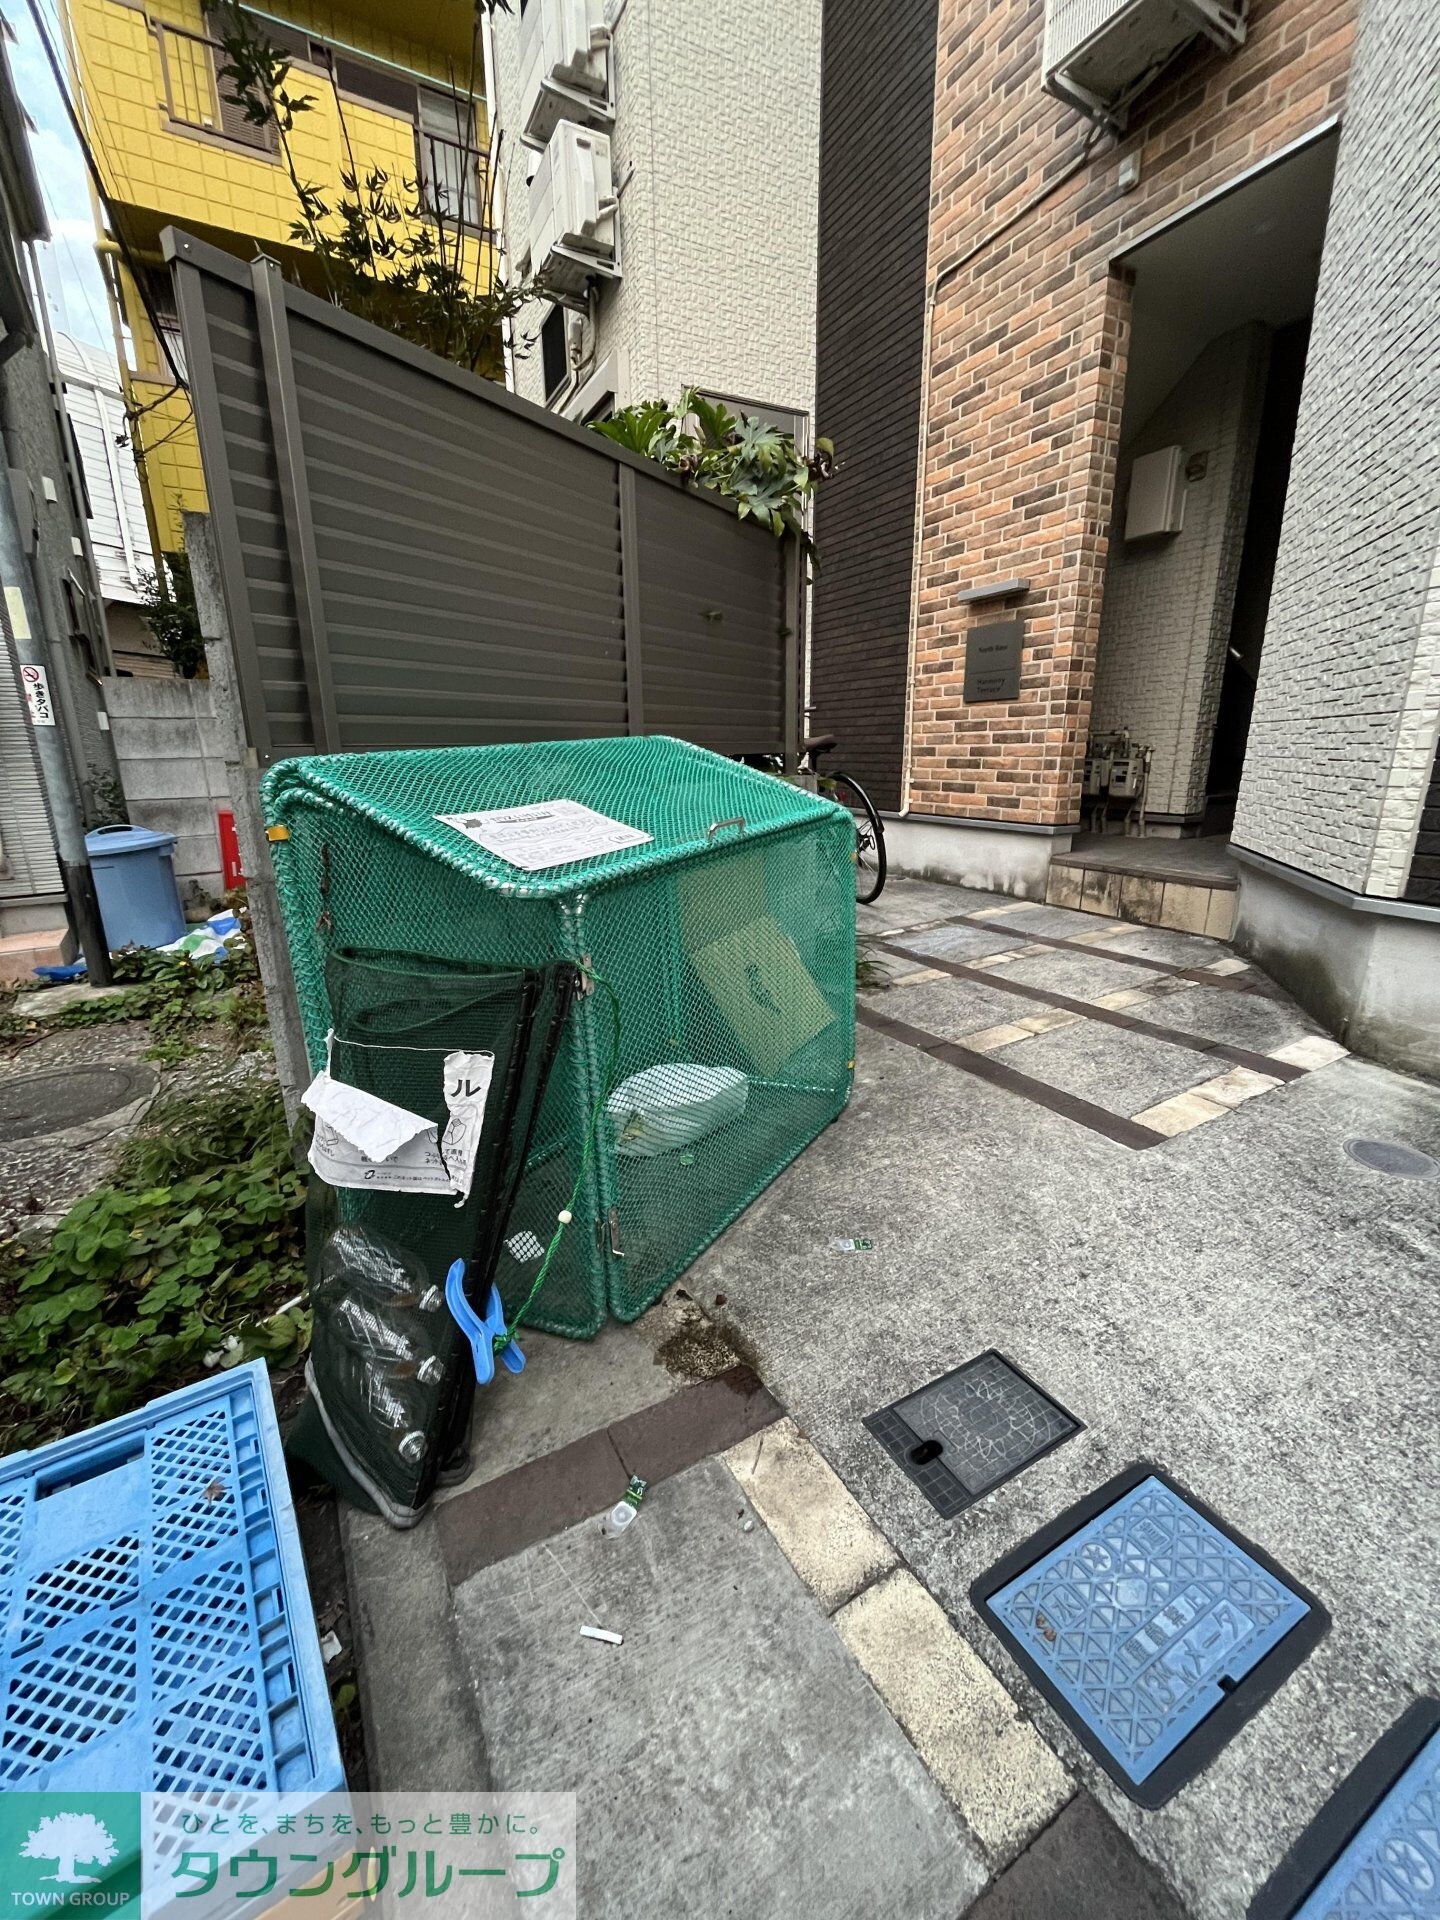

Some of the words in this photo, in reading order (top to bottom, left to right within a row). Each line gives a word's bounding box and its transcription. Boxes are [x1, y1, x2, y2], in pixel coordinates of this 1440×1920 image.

[32, 682, 49, 718] 歩きタバコ
[450, 1079, 481, 1098] ル
